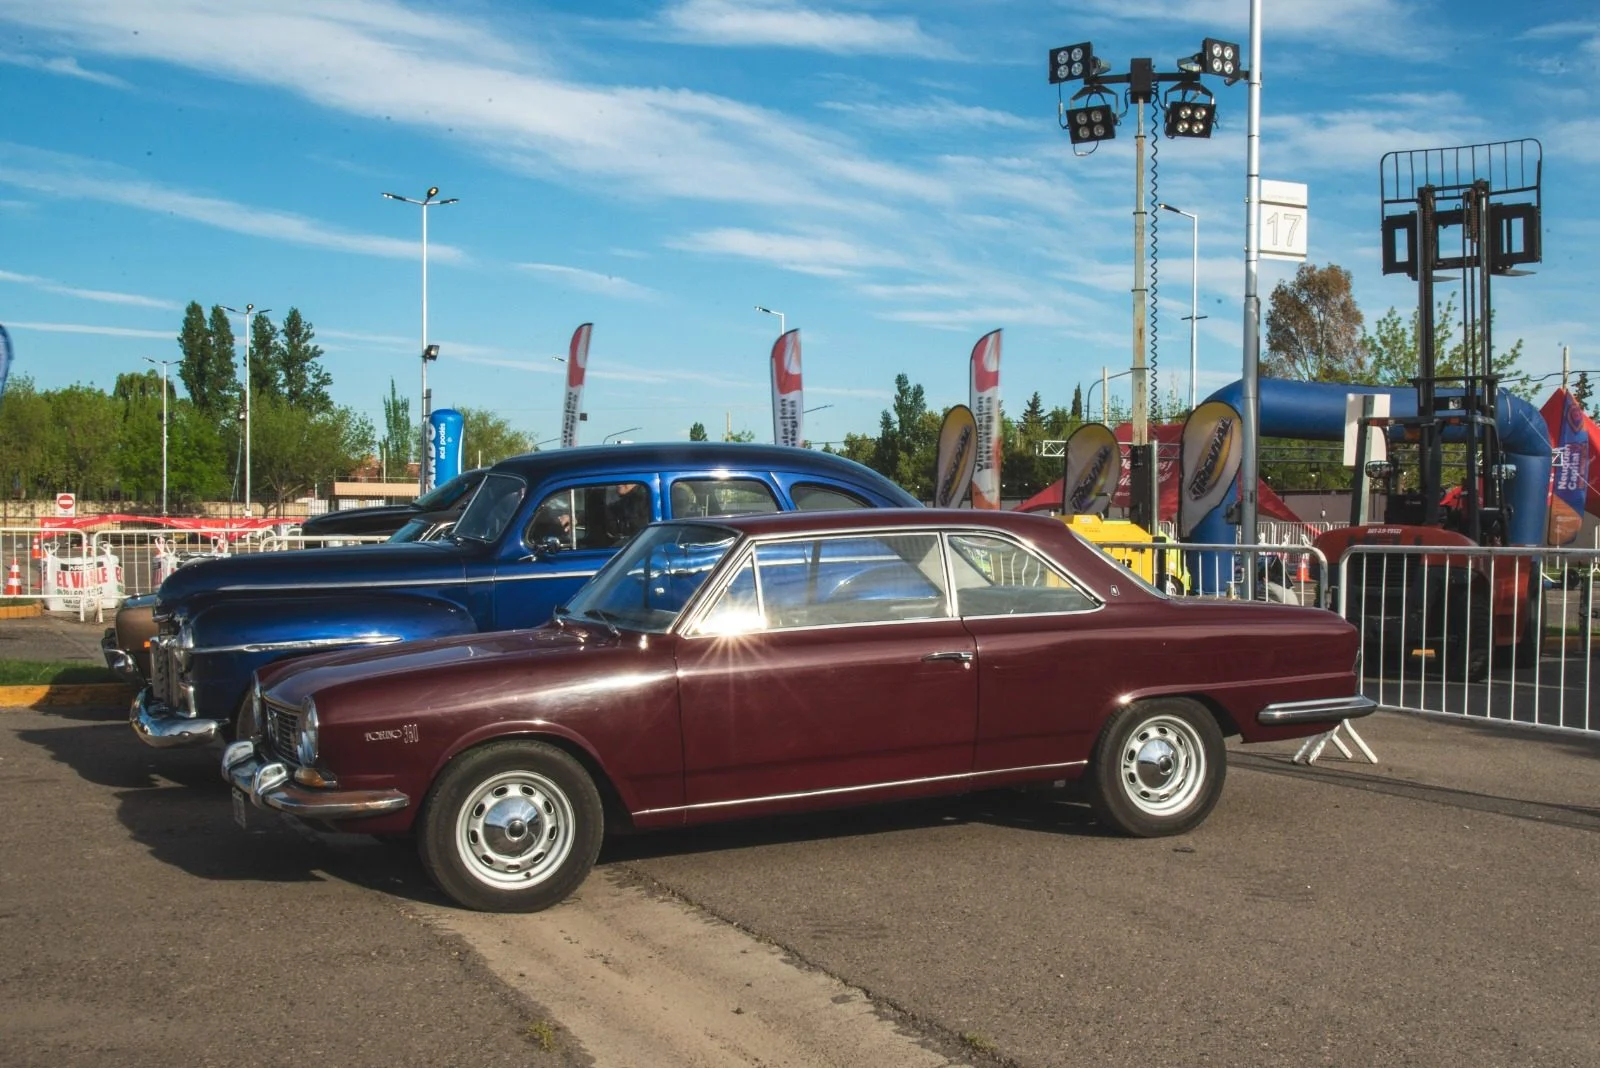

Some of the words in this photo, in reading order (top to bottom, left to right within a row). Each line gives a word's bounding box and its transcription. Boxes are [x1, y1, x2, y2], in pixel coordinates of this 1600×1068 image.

[1266, 211, 1303, 247] 17
[438, 422, 447, 446] podés
[976, 396, 985, 473] Vinculación
[984, 397, 993, 469] Estratégica
[438, 446, 446, 460] acá
[1567, 452, 1580, 491] Capital
[56, 570, 69, 589] EL
[364, 729, 403, 742] TORINO
